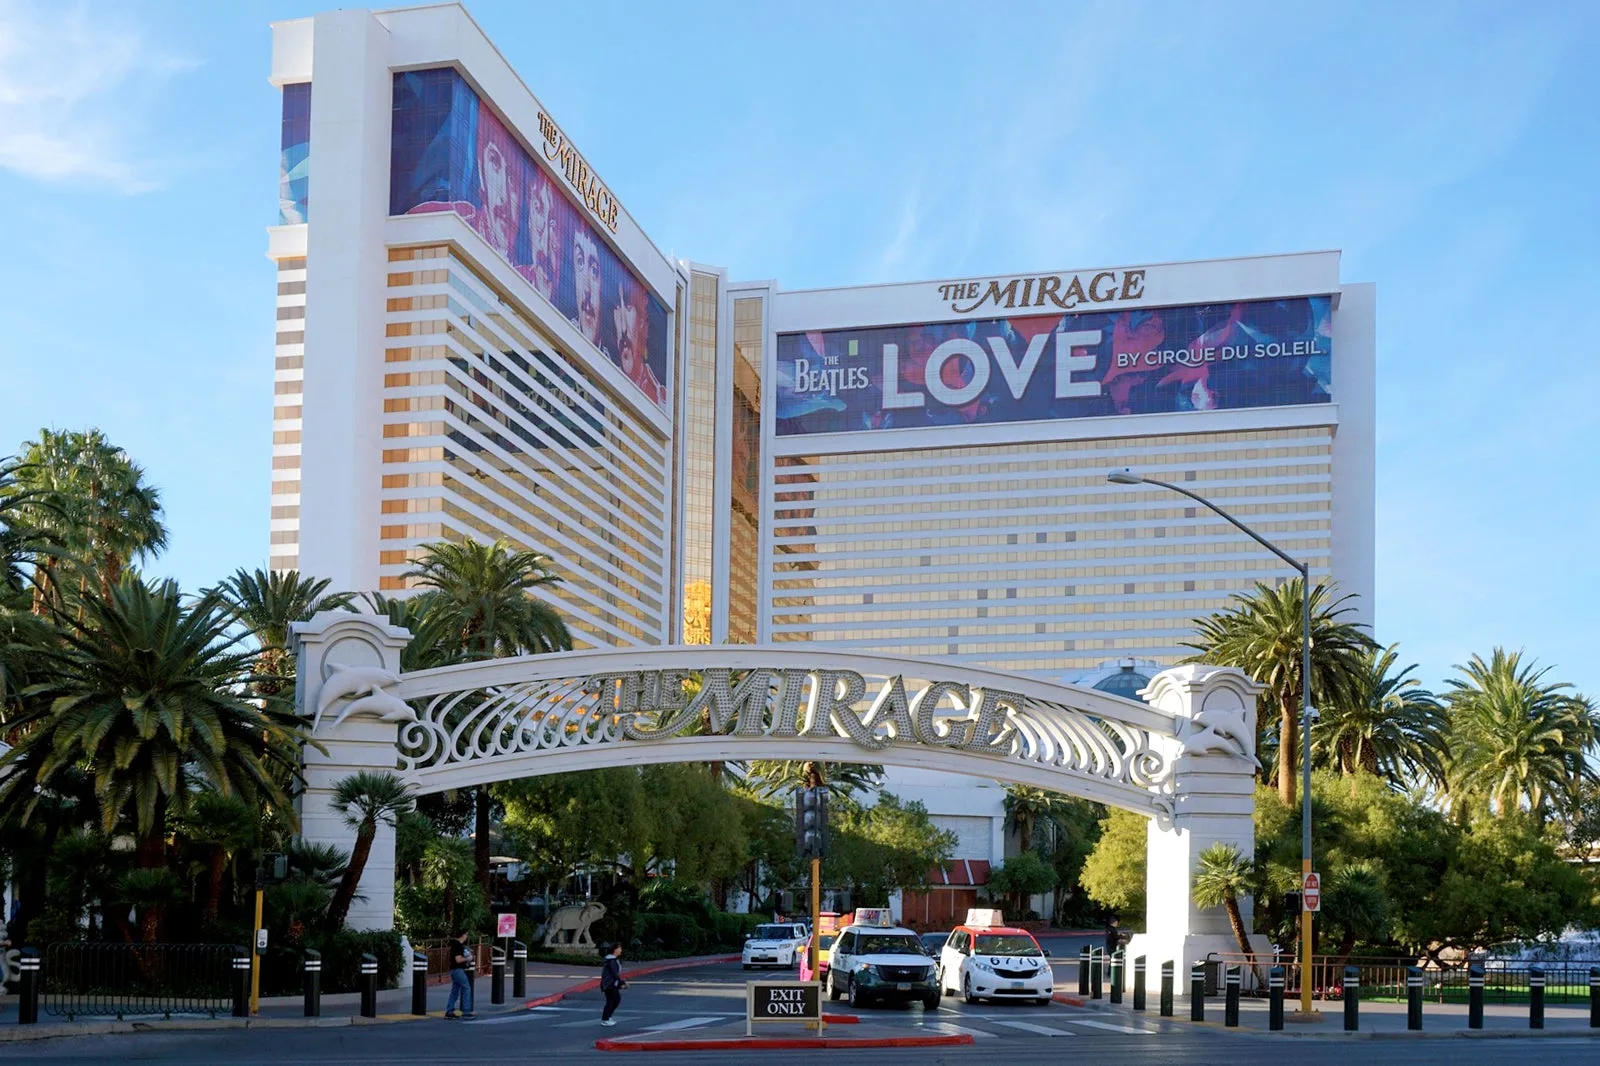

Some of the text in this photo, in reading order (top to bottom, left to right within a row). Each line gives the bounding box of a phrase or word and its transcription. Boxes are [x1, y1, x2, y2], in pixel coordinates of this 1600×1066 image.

[537, 111, 618, 235] THE MIRAGE
[938, 270, 1146, 314] THE MIRAGE
[823, 355, 840, 366] THE
[882, 330, 1103, 410] LOVE
[1117, 339, 1322, 368] BY CIRQUE DU SOLEIL
[794, 357, 869, 397] BEATLES
[587, 667, 1026, 757] THE MIRAGE
[767, 1002, 806, 1015] ONLY
[769, 989, 805, 1001] EXIT
